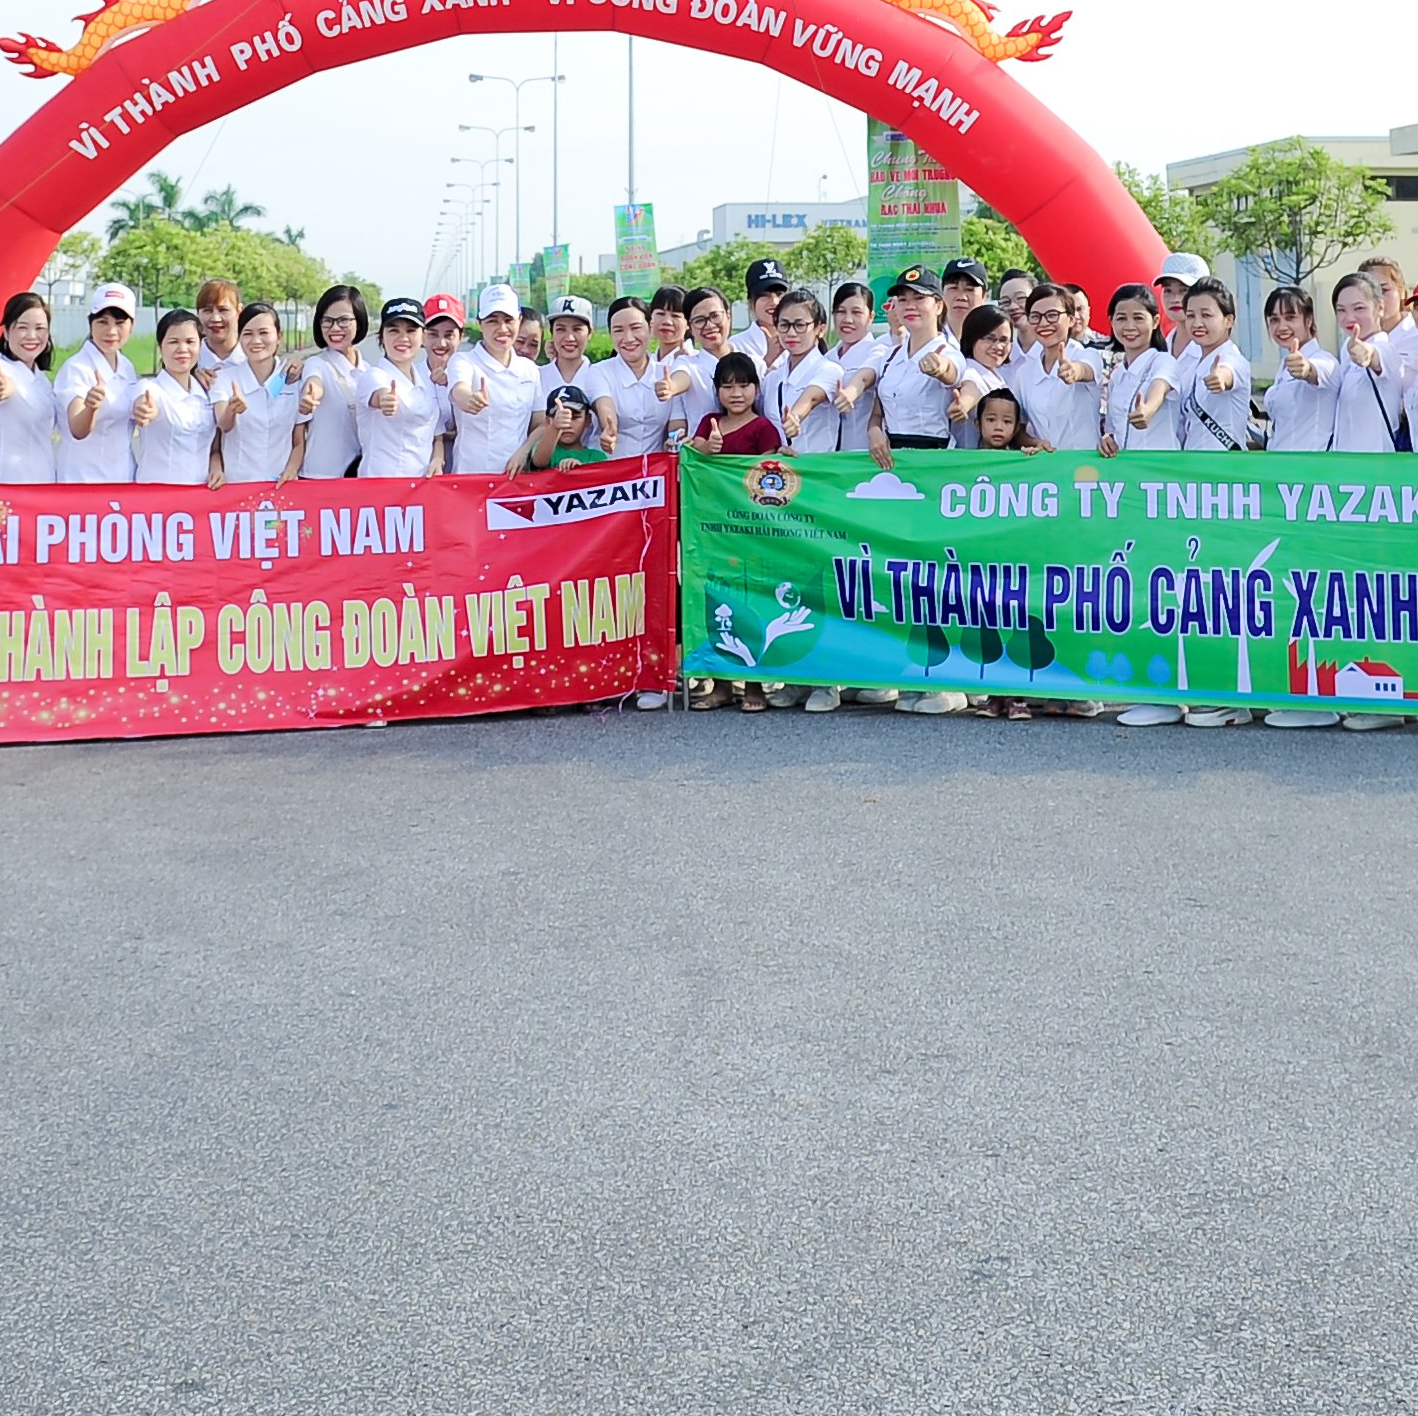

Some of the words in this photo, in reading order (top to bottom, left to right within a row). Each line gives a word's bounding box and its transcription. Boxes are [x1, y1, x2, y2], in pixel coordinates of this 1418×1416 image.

[68, 121, 110, 160] VÌ
[103, 55, 221, 136] THÀNH
[229, 13, 302, 71] PHỐ
[791, 18, 883, 77] VỮNG
[887, 59, 980, 135] MẠNH
[747, 214, 807, 229] HI-LEX
[542, 477, 660, 517] YAZAKI
[939, 476, 1059, 519] CÔNG
[1074, 480, 1125, 519] TY
[1140, 481, 1261, 521] TNHH
[37, 502, 194, 564] PHÒNG
[209, 501, 305, 569] VIỆT
[320, 505, 424, 556] NAM
[832, 543, 876, 622] VÌ
[886, 547, 1029, 631] THÀNH
[1045, 539, 1137, 636] PHỐ
[1149, 536, 1275, 639] CẢNG
[125, 591, 205, 693] LẬP
[217, 589, 331, 674] CÔNG
[341, 583, 455, 669] ĐOÀN
[464, 575, 551, 669] VIỆT
[561, 572, 646, 646] NAM
